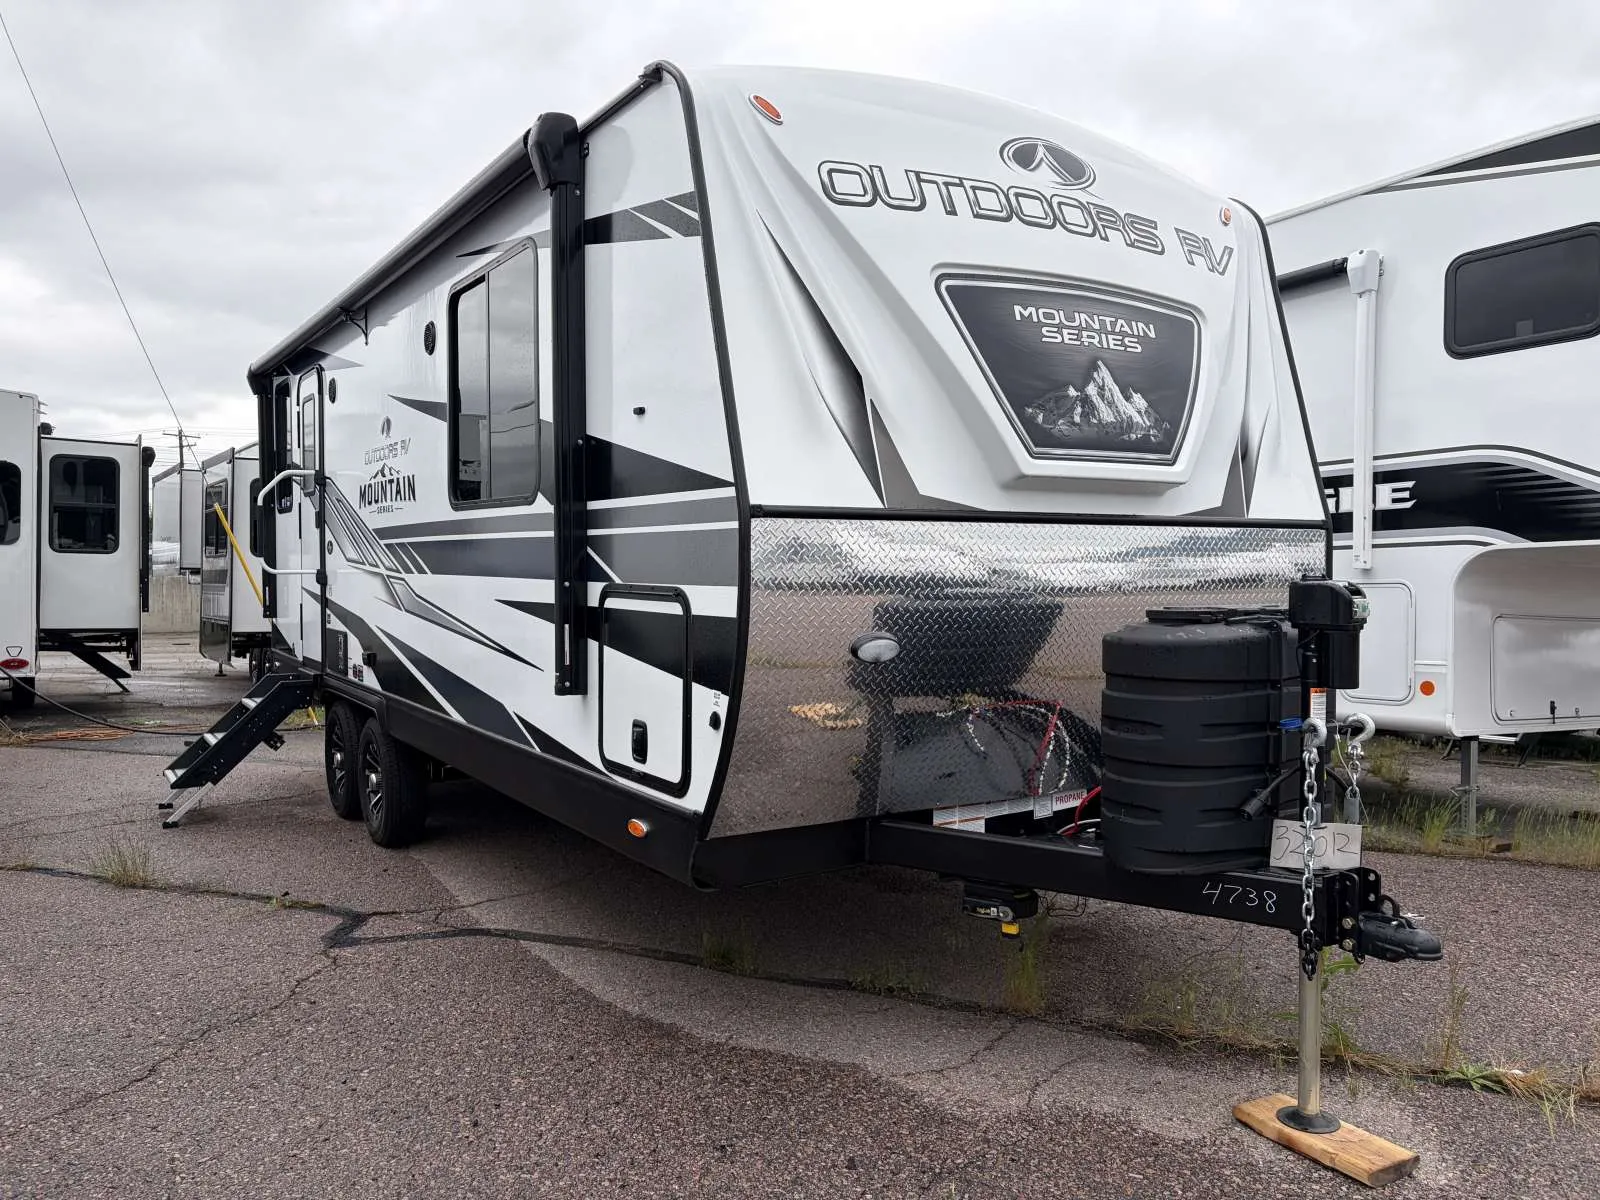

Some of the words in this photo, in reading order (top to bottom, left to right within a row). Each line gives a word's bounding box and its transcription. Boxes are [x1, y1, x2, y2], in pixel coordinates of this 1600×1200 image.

[818, 160, 1166, 256] OUTDOORS
[1175, 227, 1234, 277] RV
[1013, 304, 1156, 339] MOUNTAIN
[1041, 326, 1142, 353] SERIES
[359, 474, 417, 509] MOUNTAIN
[1055, 791, 1084, 805] PROPANE
[1202, 881, 1277, 913] 4738
